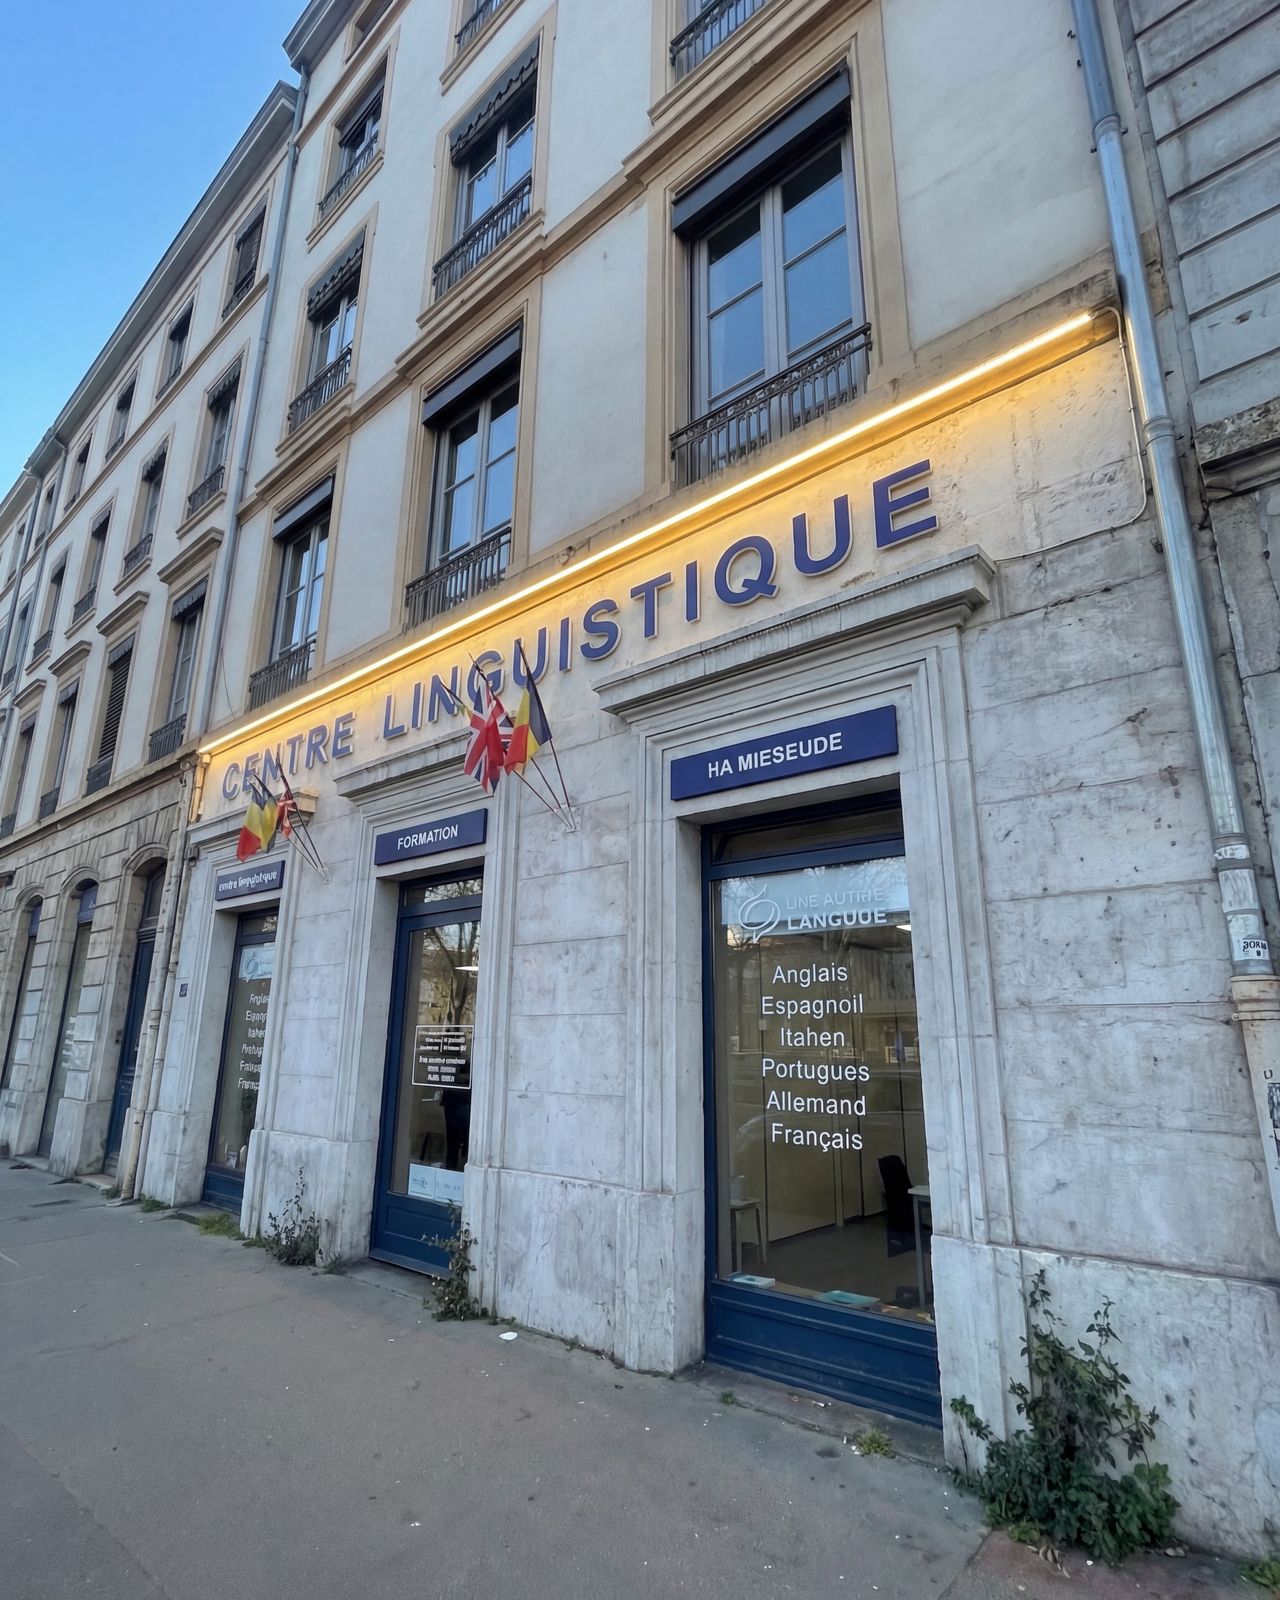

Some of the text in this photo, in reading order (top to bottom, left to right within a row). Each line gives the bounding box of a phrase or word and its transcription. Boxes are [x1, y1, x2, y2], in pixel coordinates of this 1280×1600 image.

[222, 458, 939, 800] CENTRE LINGUISTIQUE
[708, 732, 843, 778] HA MIESEUDE
[397, 824, 459, 851] FORMATION
[772, 962, 849, 988] Anglais
[761, 993, 864, 1019] Espagnoil
[780, 1027, 846, 1047] Itahen
[762, 1058, 870, 1085] Portugues
[766, 1090, 867, 1117] Allemand
[771, 1122, 864, 1153] Français
